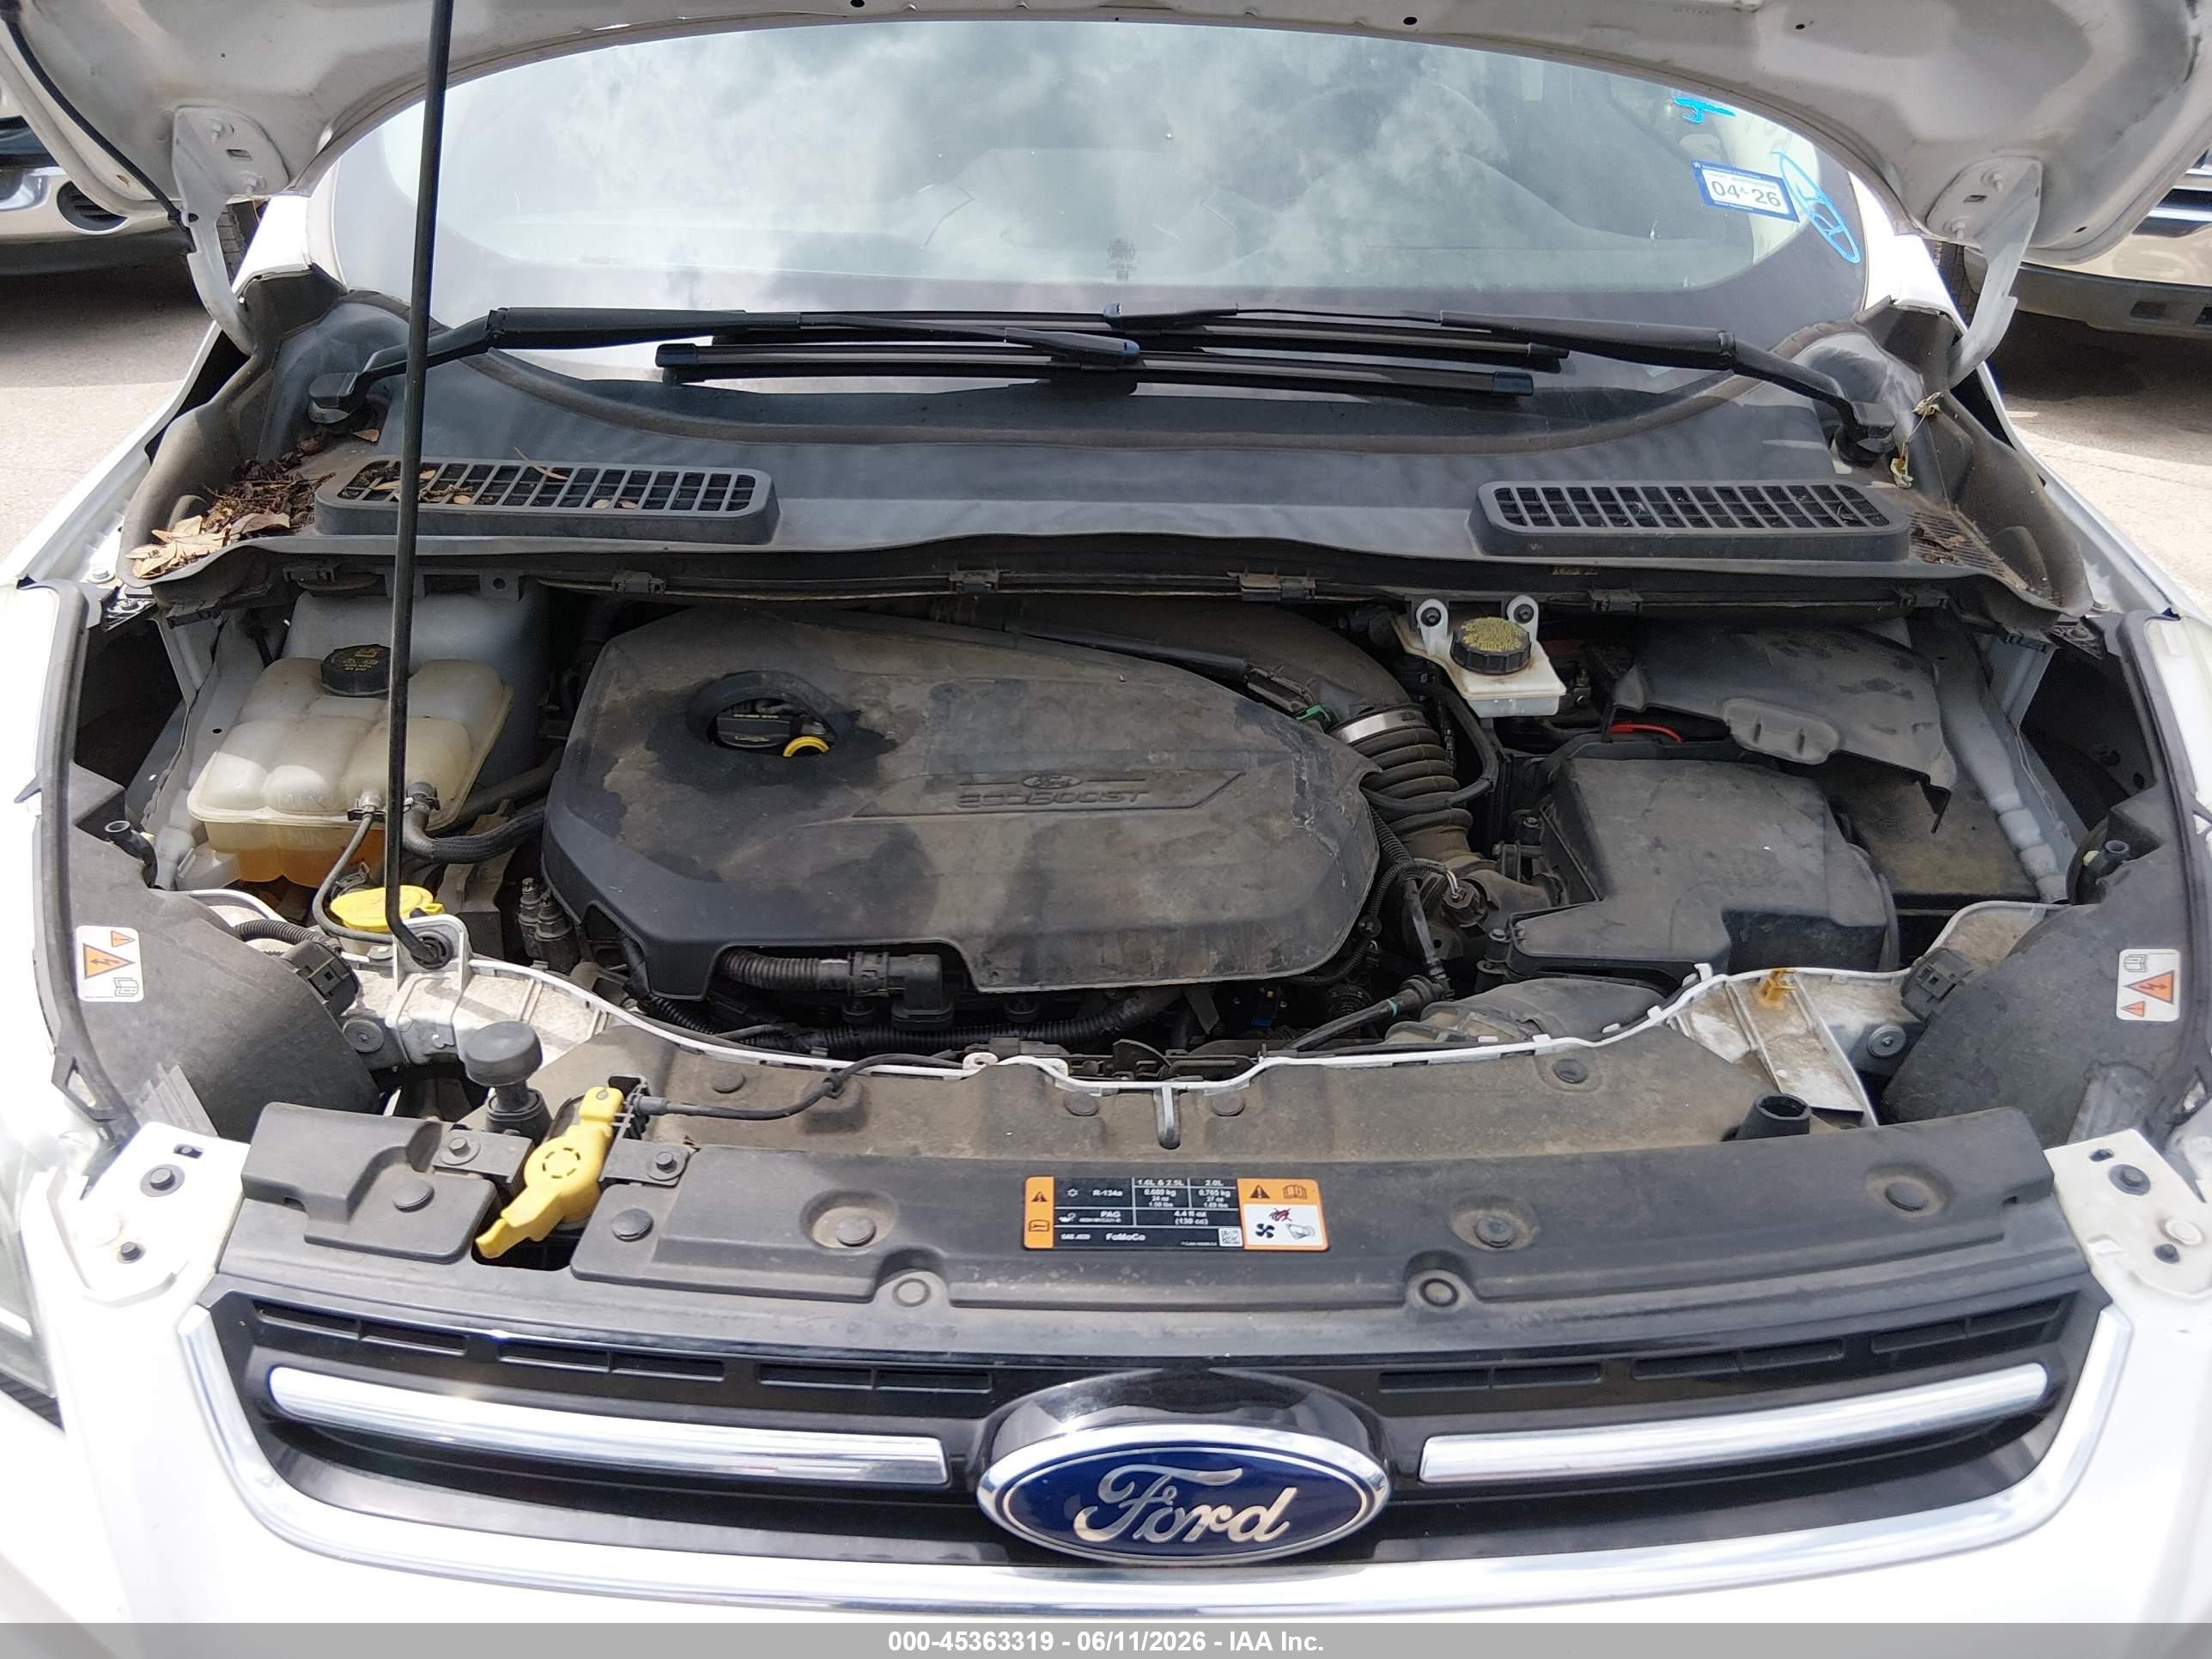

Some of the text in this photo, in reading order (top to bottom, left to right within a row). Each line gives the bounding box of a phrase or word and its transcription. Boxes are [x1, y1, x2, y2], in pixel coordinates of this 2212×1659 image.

[1711, 180, 1741, 199] 04
[1751, 188, 1782, 207] 26
[957, 791, 1151, 808] ECOBOOST
[1166, 1188, 1176, 1197] kg
[1220, 1189, 1231, 1198] kg
[1105, 1232, 1146, 1241] FoMoCo
[1073, 1463, 1299, 1544] Ford
